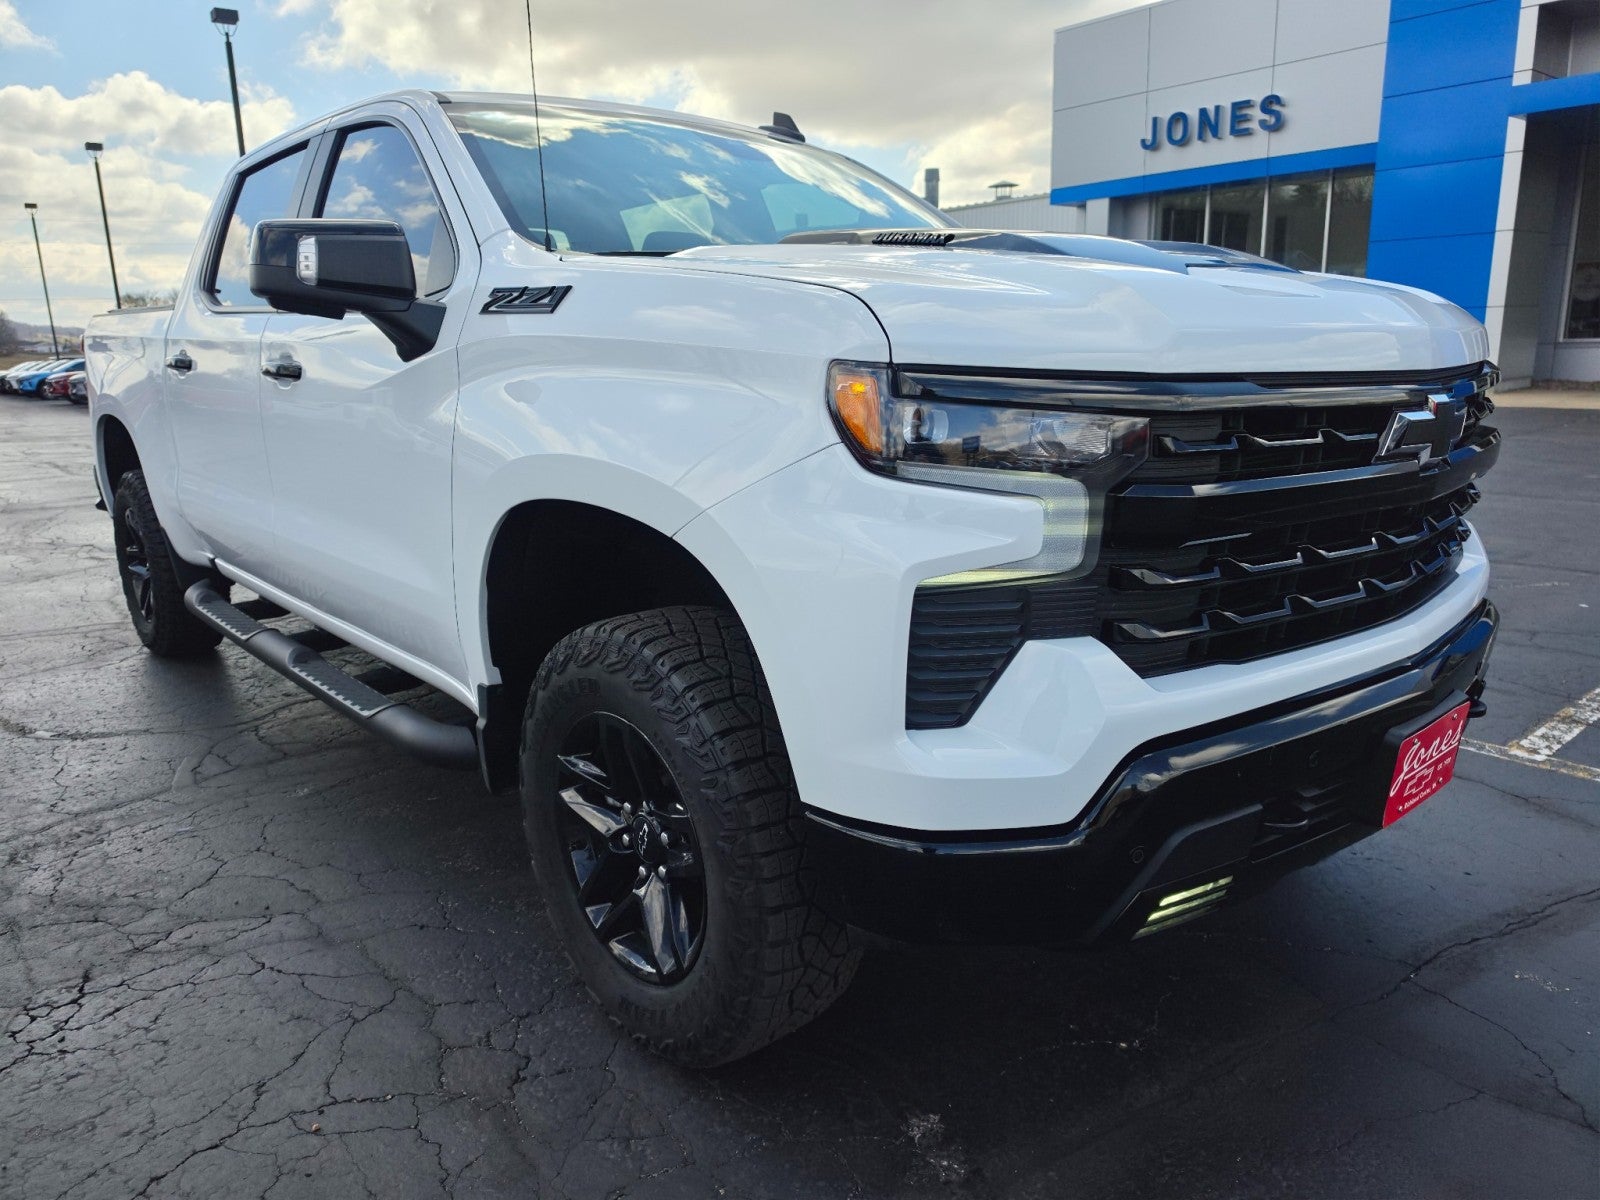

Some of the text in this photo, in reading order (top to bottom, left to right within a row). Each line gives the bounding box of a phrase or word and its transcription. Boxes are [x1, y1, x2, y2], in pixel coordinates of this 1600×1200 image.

[1140, 94, 1286, 151] JONES
[872, 232, 955, 247] DURAMAX
[479, 285, 573, 315] Z71
[1390, 720, 1464, 797] Jones
